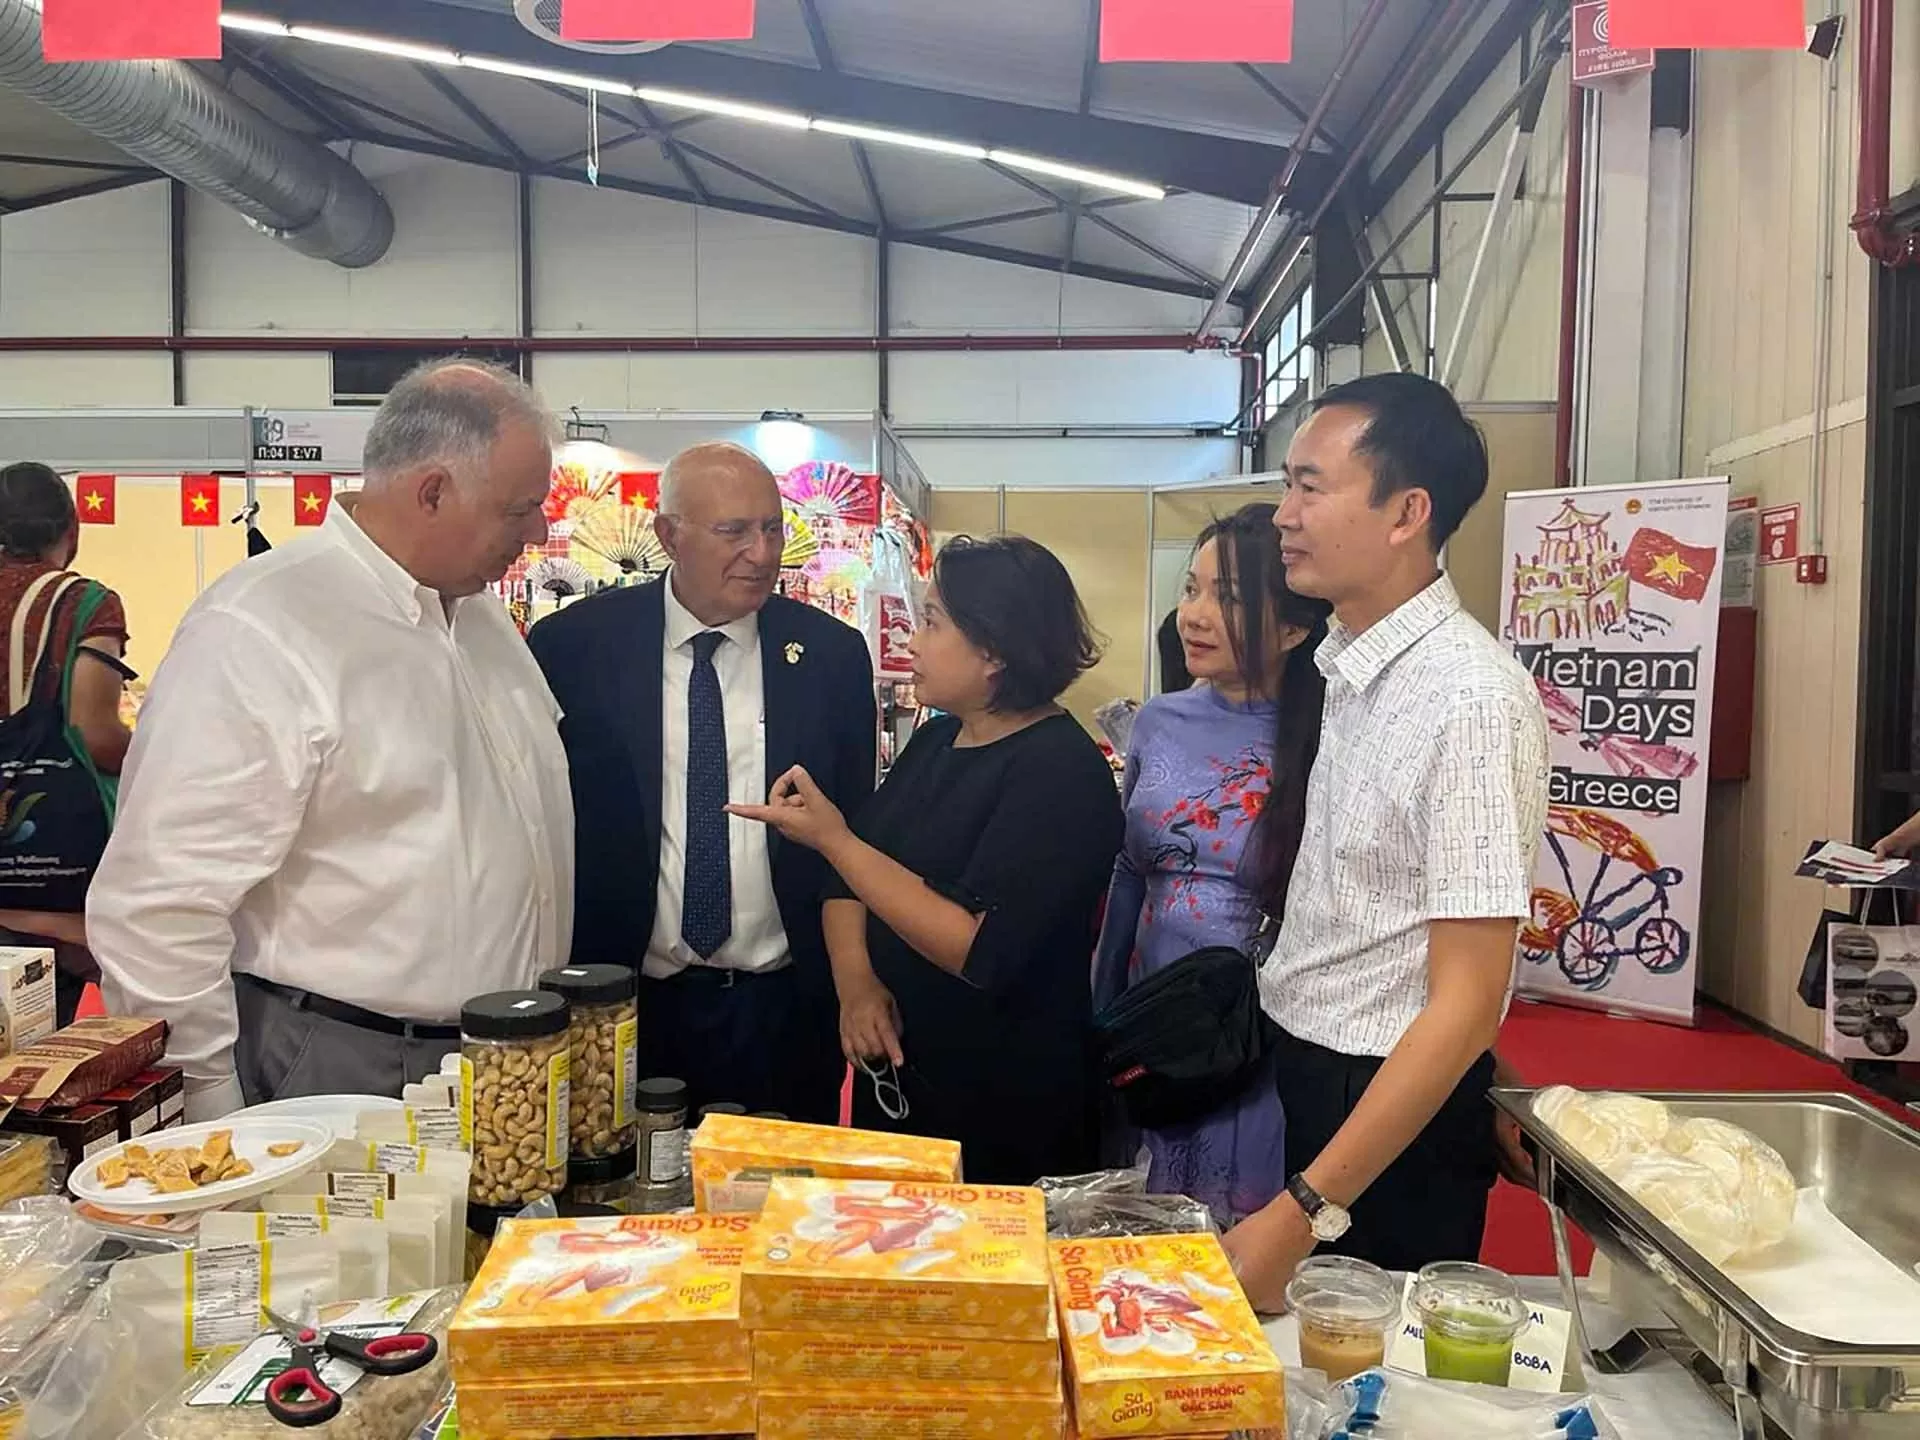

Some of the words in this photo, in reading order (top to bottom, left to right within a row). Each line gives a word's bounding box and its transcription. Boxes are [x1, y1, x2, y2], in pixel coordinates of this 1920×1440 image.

[1515, 649, 1695, 689] Vietnam
[1583, 695, 1692, 742] Days
[1549, 771, 1678, 809] Greece
[892, 1183, 980, 1204] Giang
[985, 1188, 1026, 1205] Sa
[618, 1216, 704, 1233] Giang
[711, 1215, 750, 1232] Sa
[1060, 1245, 1086, 1266] Sa
[1065, 1266, 1094, 1311] Giang
[1403, 1324, 1425, 1340] MIL
[1513, 1351, 1553, 1374] BOBA
[1123, 1392, 1145, 1407] Sa
[1111, 1399, 1154, 1424] Giang
